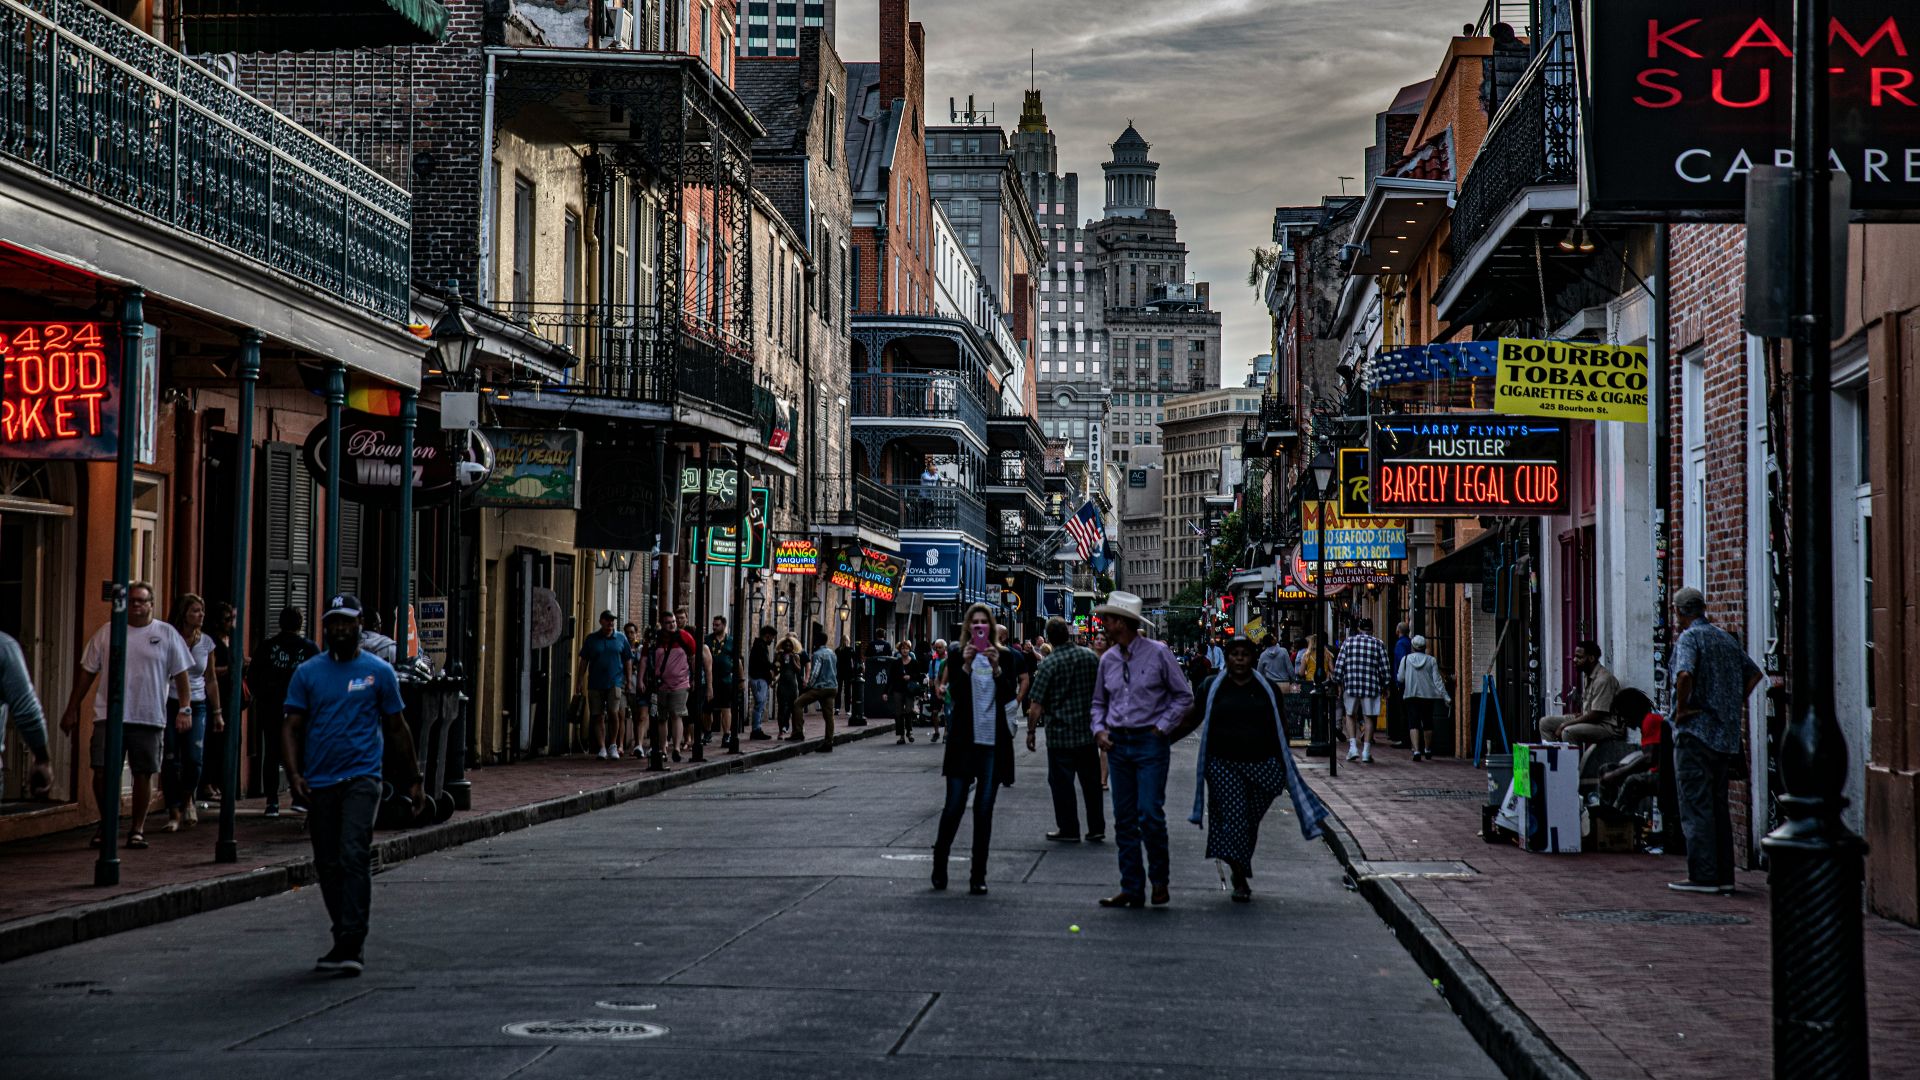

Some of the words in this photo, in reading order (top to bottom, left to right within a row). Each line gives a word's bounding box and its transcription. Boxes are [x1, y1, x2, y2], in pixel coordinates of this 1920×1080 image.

[1632, 67, 1919, 109] SUR
[1503, 343, 1648, 369] BOURBON
[1505, 364, 1648, 390] TOBACCO
[1500, 384, 1583, 401] CIGARETTES
[1586, 391, 1598, 402] &
[1601, 391, 1648, 406] CIGARS
[1540, 402, 1555, 410] 425
[1558, 403, 1594, 413] Bourbon
[1597, 406, 1608, 414] St.
[1413, 424, 1459, 436] LARRY
[1470, 425, 1528, 437] FLYNT'S
[347, 429, 438, 459] Bouron
[1131, 471, 1145, 479] AC
[1382, 464, 1449, 503] BARELY
[1455, 464, 1510, 504] LEGAL
[1514, 464, 1559, 503] CLUB
[782, 540, 811, 549] MANGO
[776, 547, 818, 558] MANGO
[1324, 545, 1352, 560] YSTERS
[929, 567, 951, 575] SONESTA
[1308, 561, 1336, 571] CHKEN
[1361, 560, 1387, 570] SHACK
[1334, 567, 1374, 575] AUTHENTIC
[1333, 576, 1365, 584] ORLEANS
[1366, 575, 1395, 584] CUISINE
[421, 621, 445, 629] MENU
